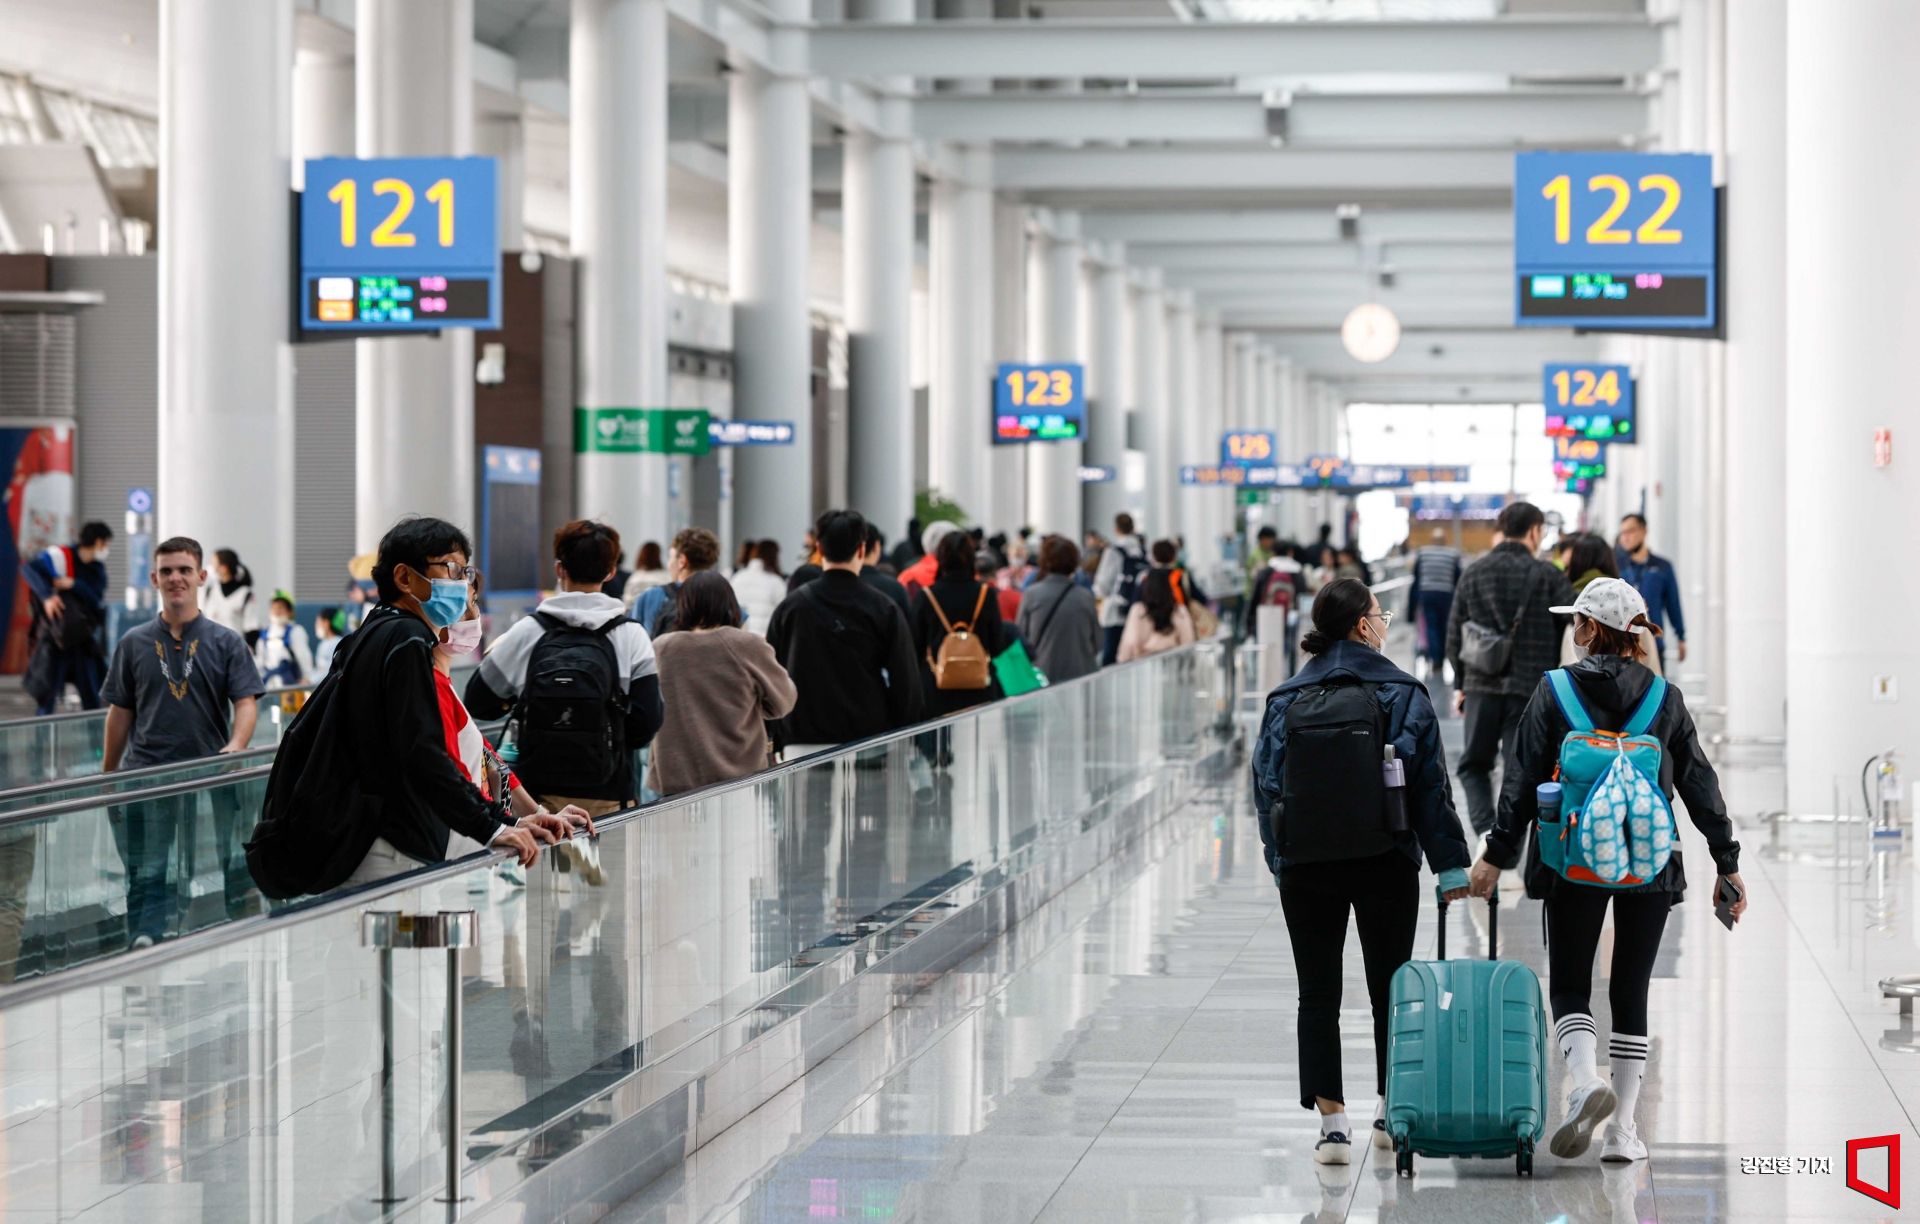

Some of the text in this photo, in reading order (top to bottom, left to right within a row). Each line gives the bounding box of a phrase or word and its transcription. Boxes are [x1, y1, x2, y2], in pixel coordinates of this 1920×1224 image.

[328, 178, 454, 247] 121
[1542, 175, 1682, 244] 122
[1007, 371, 1072, 406] 123
[1552, 370, 1621, 406] 124
